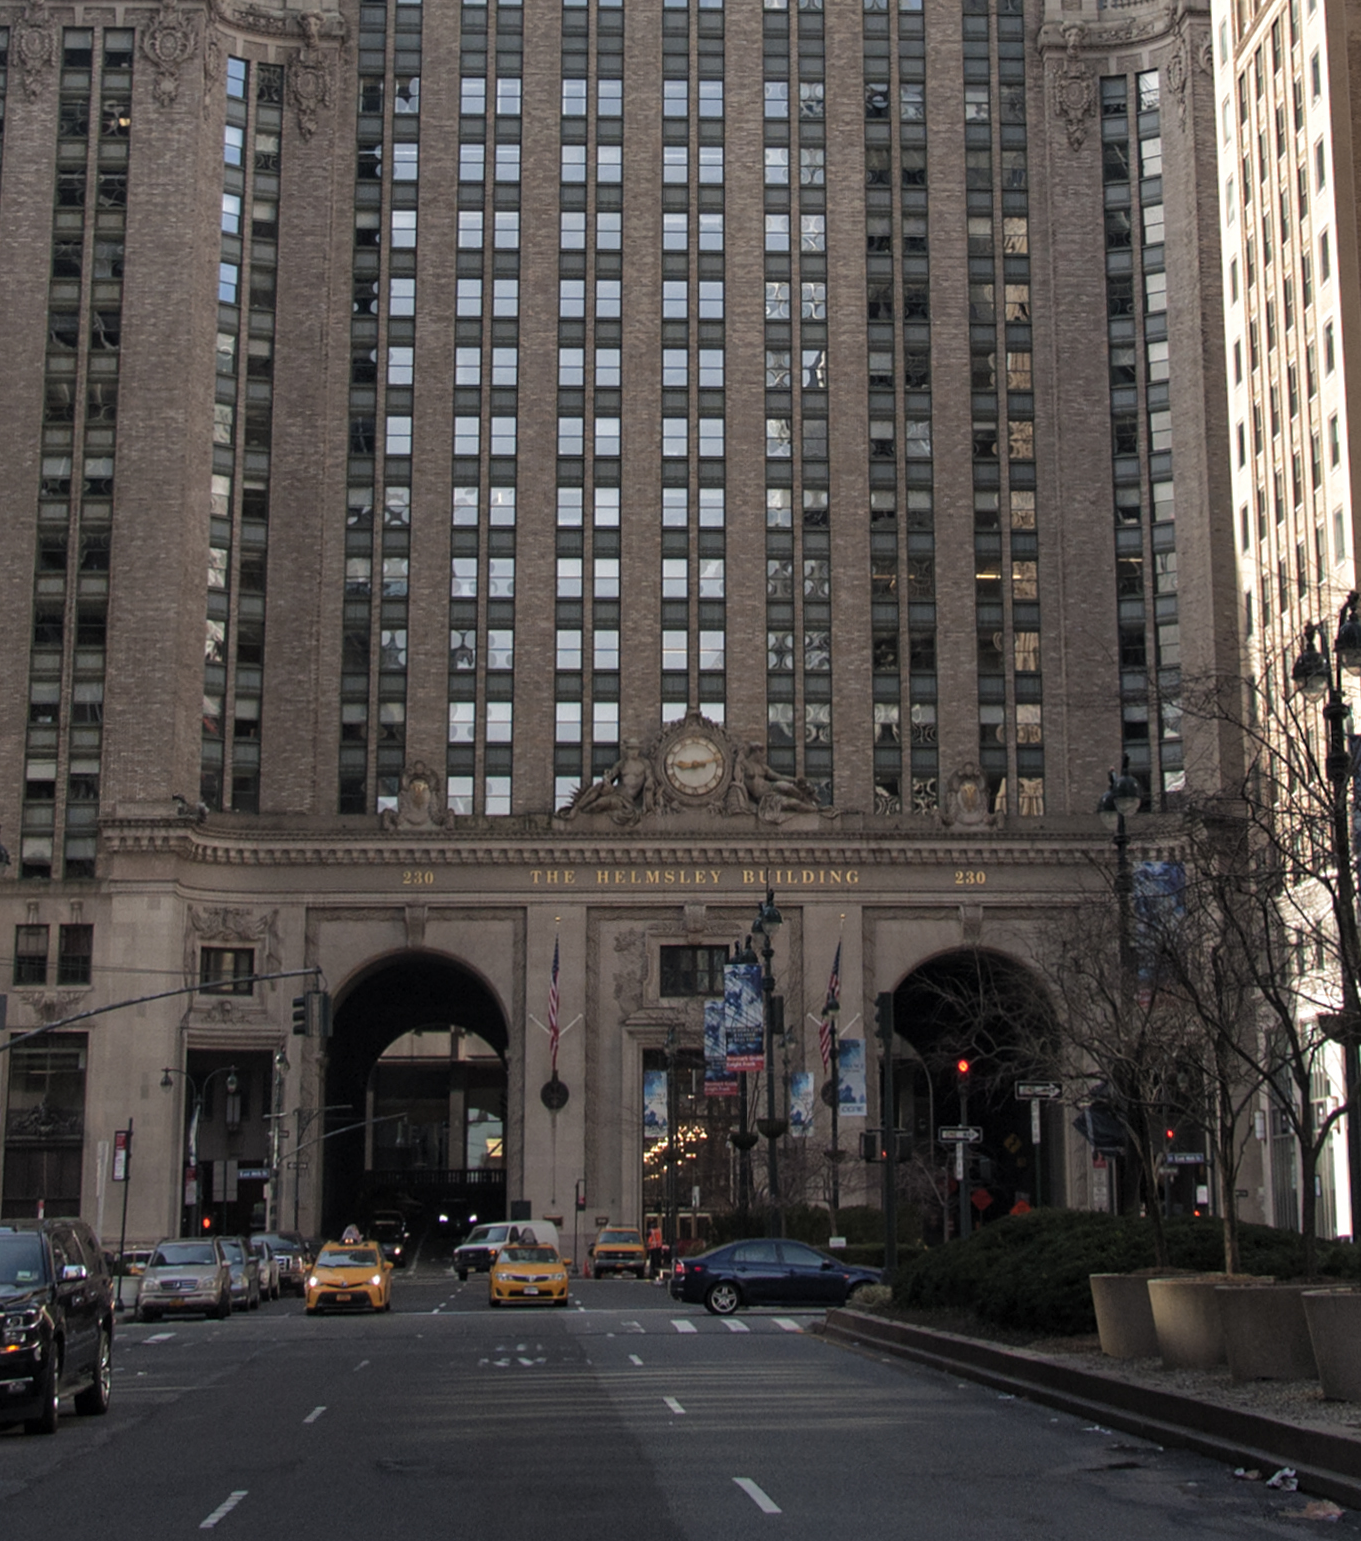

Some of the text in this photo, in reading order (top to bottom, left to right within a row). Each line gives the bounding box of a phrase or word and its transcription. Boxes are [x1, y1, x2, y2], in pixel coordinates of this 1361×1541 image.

[402, 871, 434, 885] 230
[530, 870, 860, 885] THE HELMSLEY BUILDING
[955, 871, 986, 885] 230
